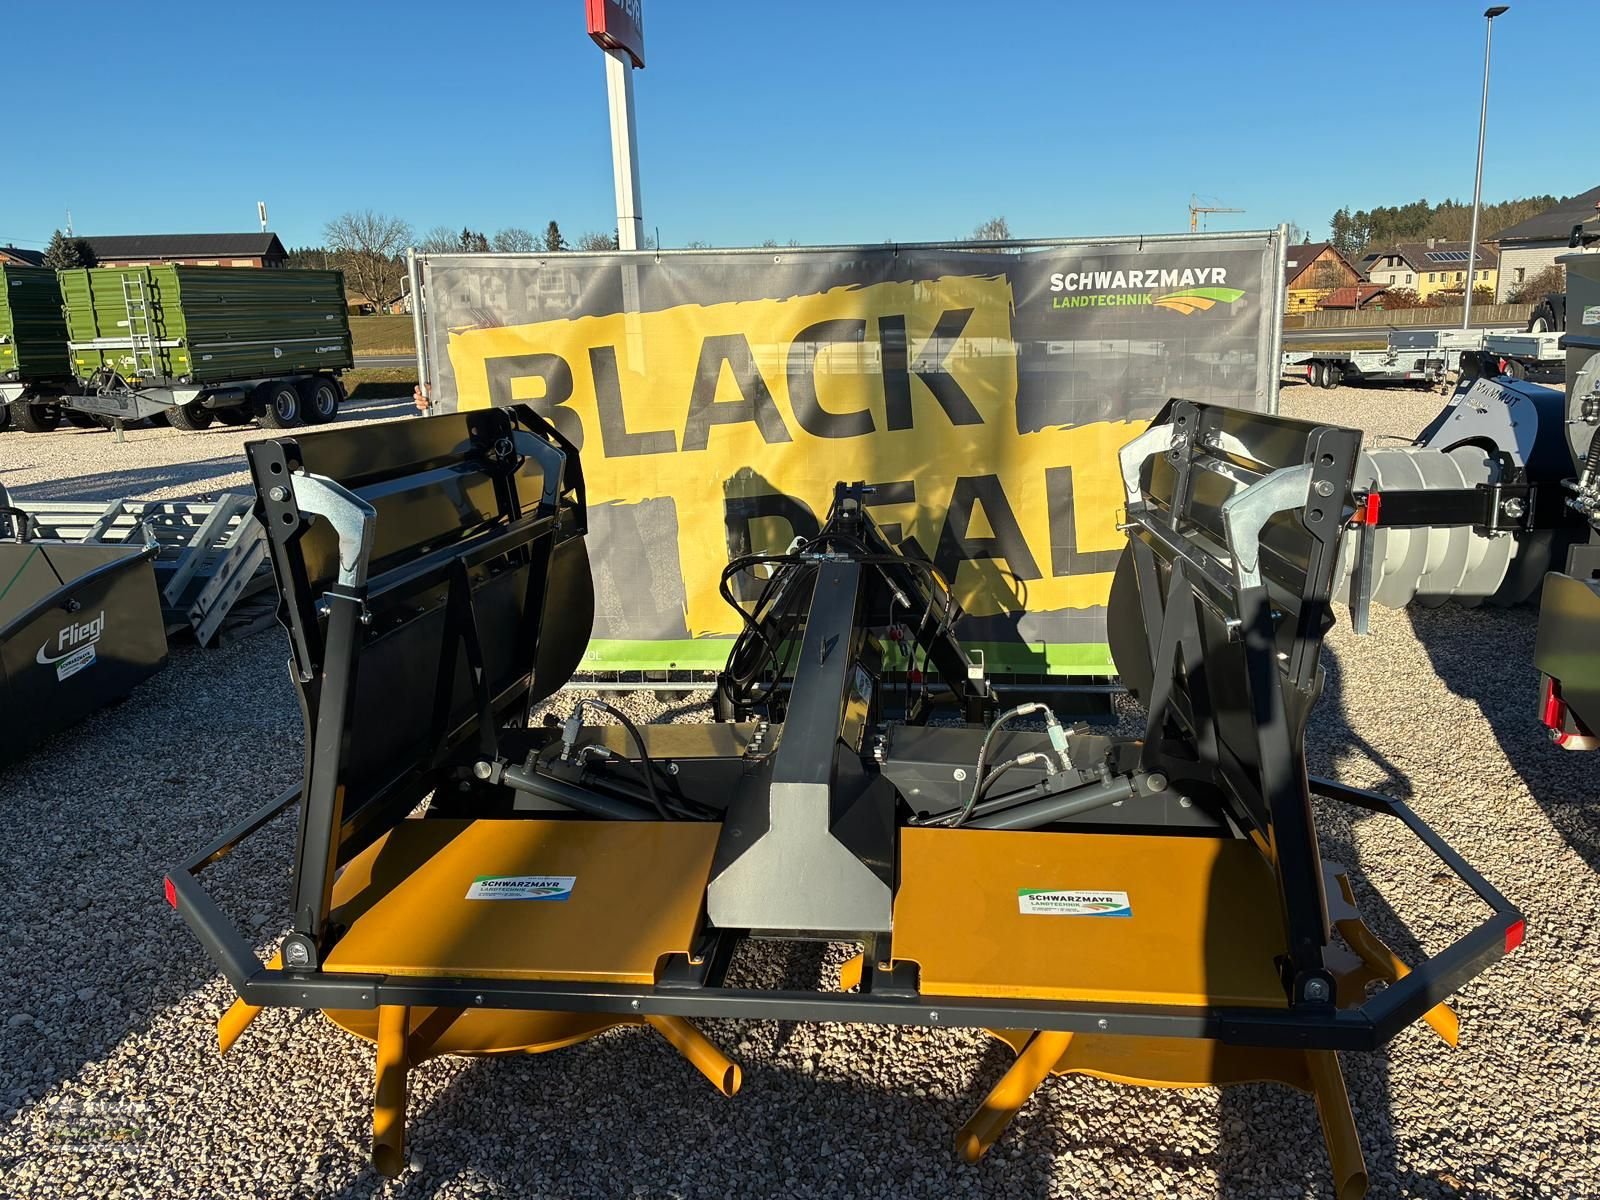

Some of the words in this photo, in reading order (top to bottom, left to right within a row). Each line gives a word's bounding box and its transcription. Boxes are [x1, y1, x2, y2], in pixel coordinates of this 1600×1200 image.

[1050, 267, 1227, 292] SCHWARZMAYR
[1053, 293, 1153, 309] LANDTECHNIK
[485, 307, 985, 458] BLACK
[58, 610, 105, 651] Fliegl
[1028, 894, 1113, 903] SCHWARZMAYR
